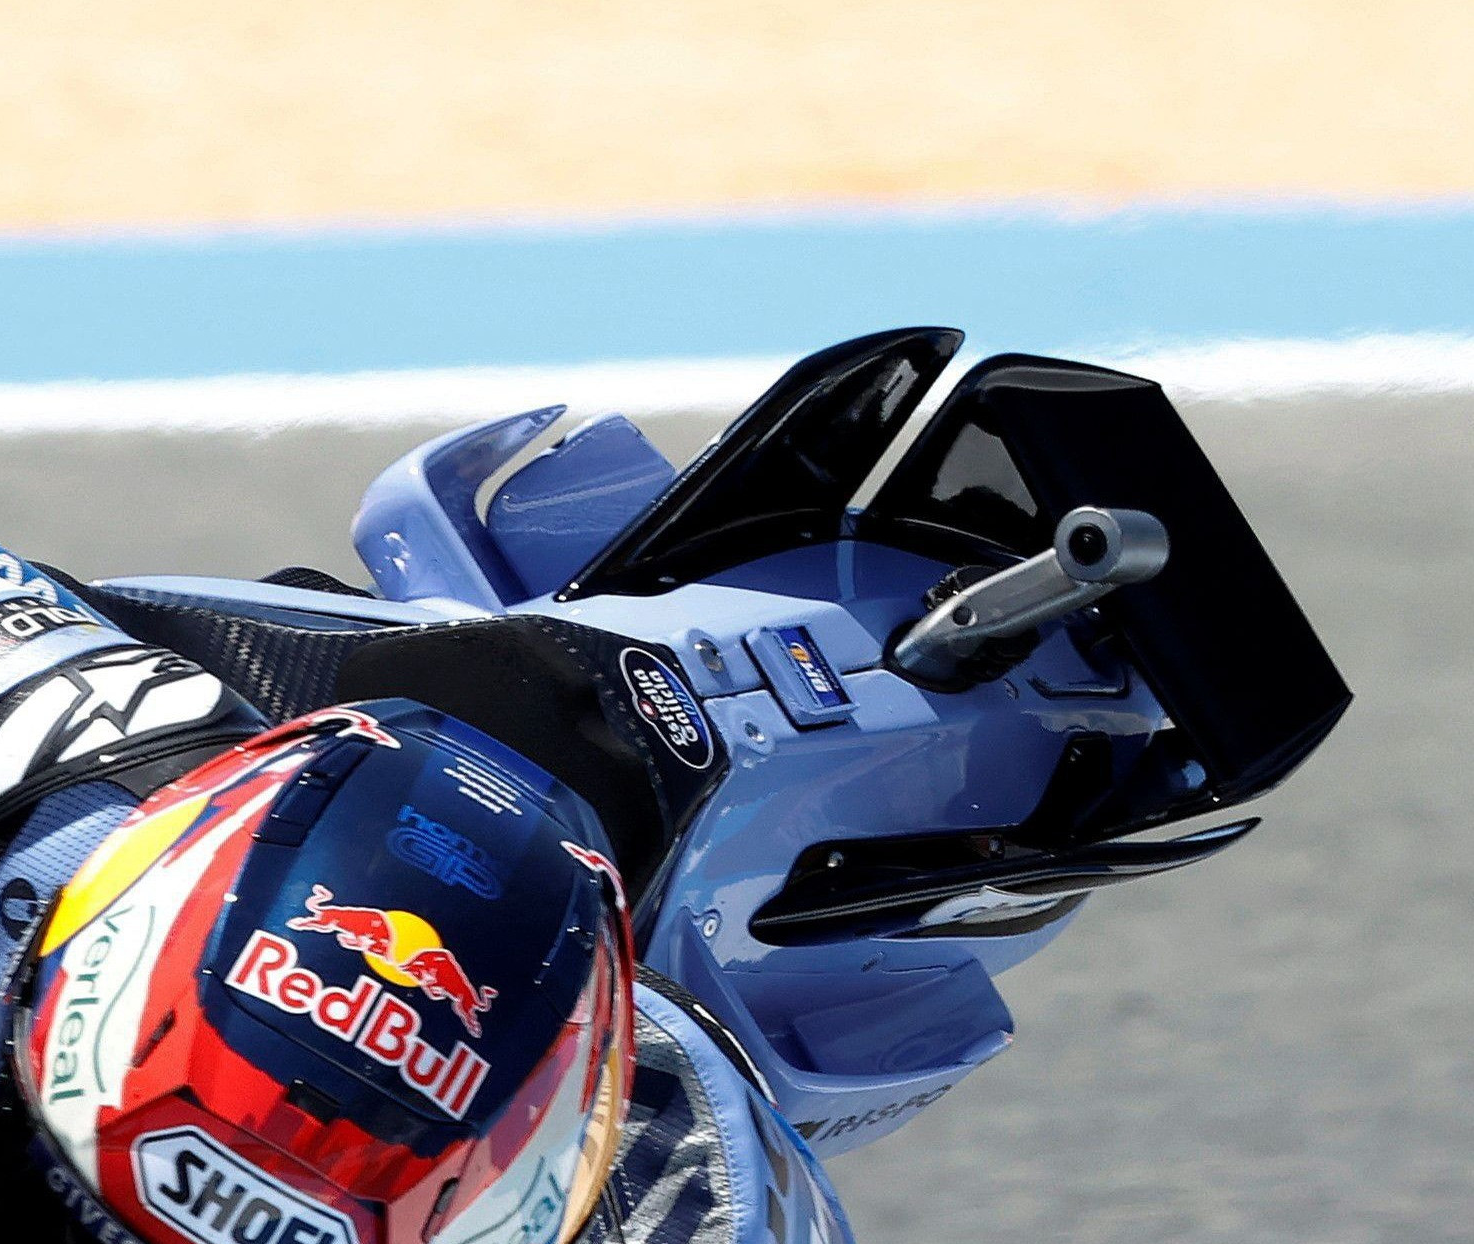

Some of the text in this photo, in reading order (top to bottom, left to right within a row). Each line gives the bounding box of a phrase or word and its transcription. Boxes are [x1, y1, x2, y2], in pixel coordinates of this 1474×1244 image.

[633, 669, 690, 747] Estrella
[649, 669, 699, 743] Galicia
[49, 904, 135, 1105] verleal
[224, 929, 492, 1121] Red Bull
